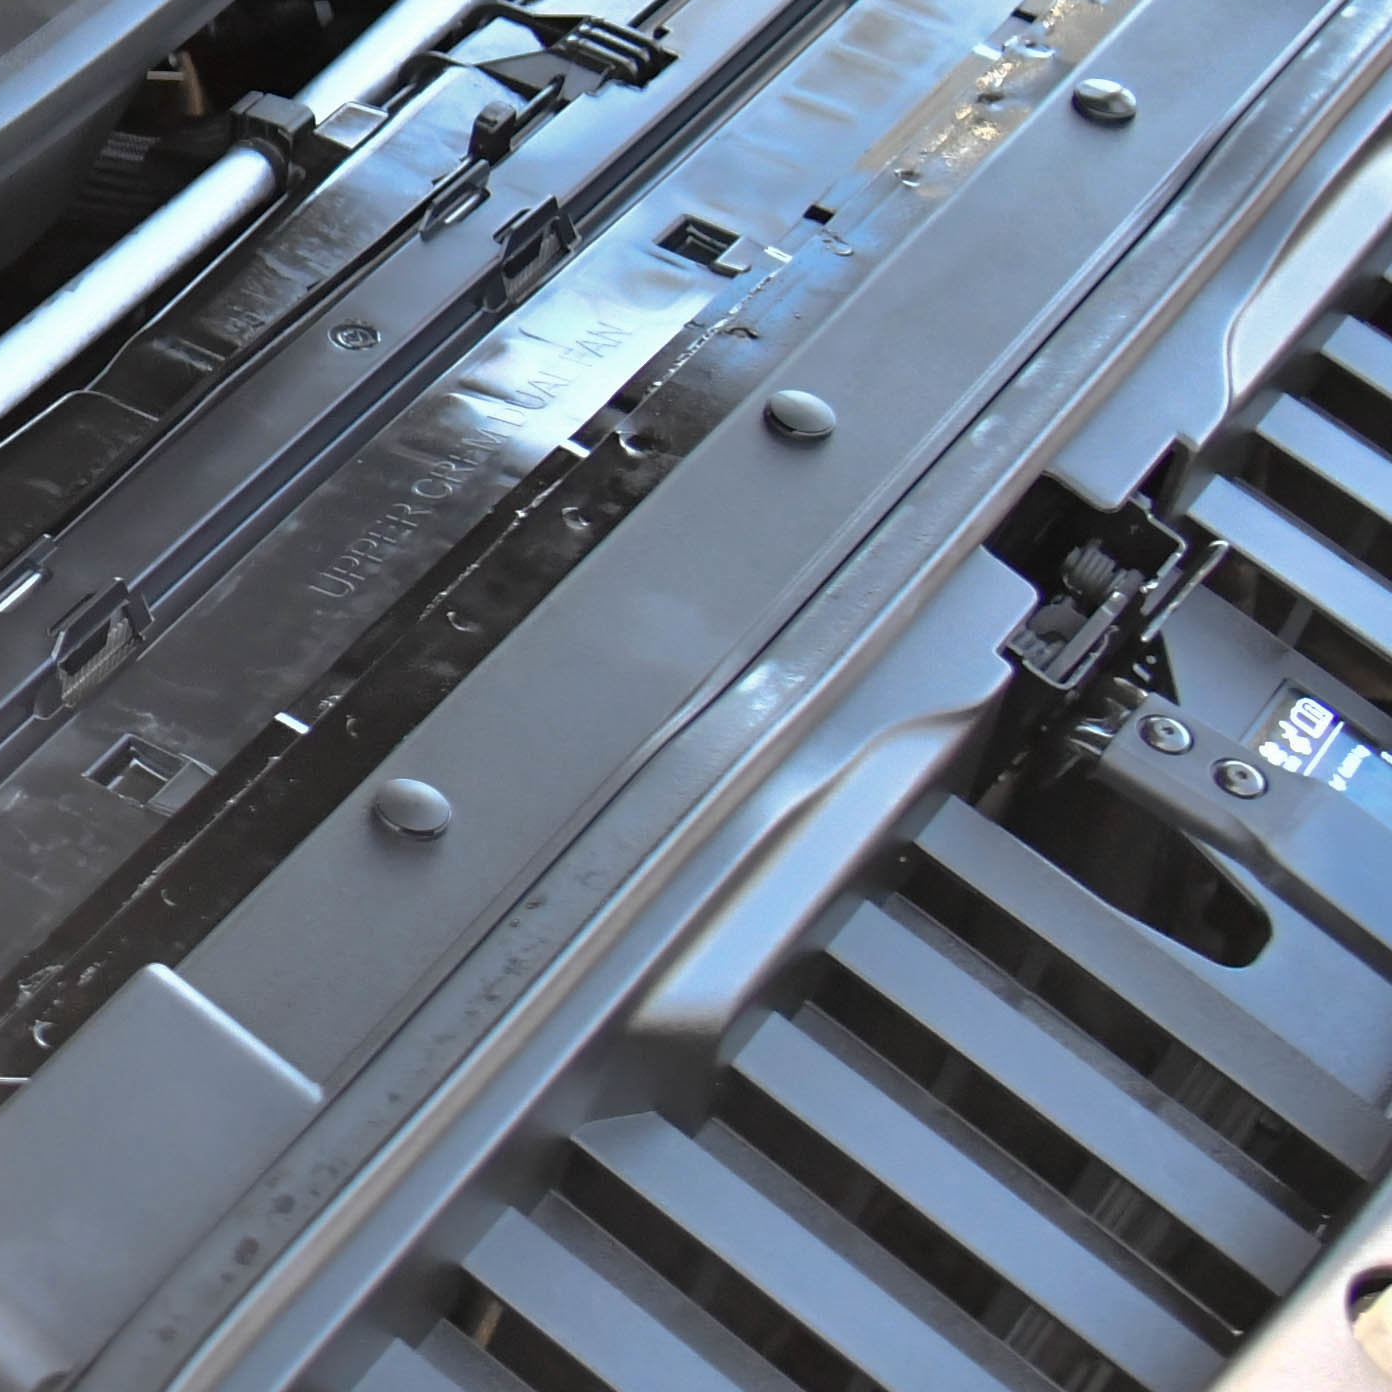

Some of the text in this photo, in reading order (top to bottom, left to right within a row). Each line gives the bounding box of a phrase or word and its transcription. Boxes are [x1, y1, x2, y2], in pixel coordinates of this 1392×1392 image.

[309, 503, 432, 598] UPPER
[486, 370, 580, 428] DUAL
[558, 321, 633, 368] FAN
